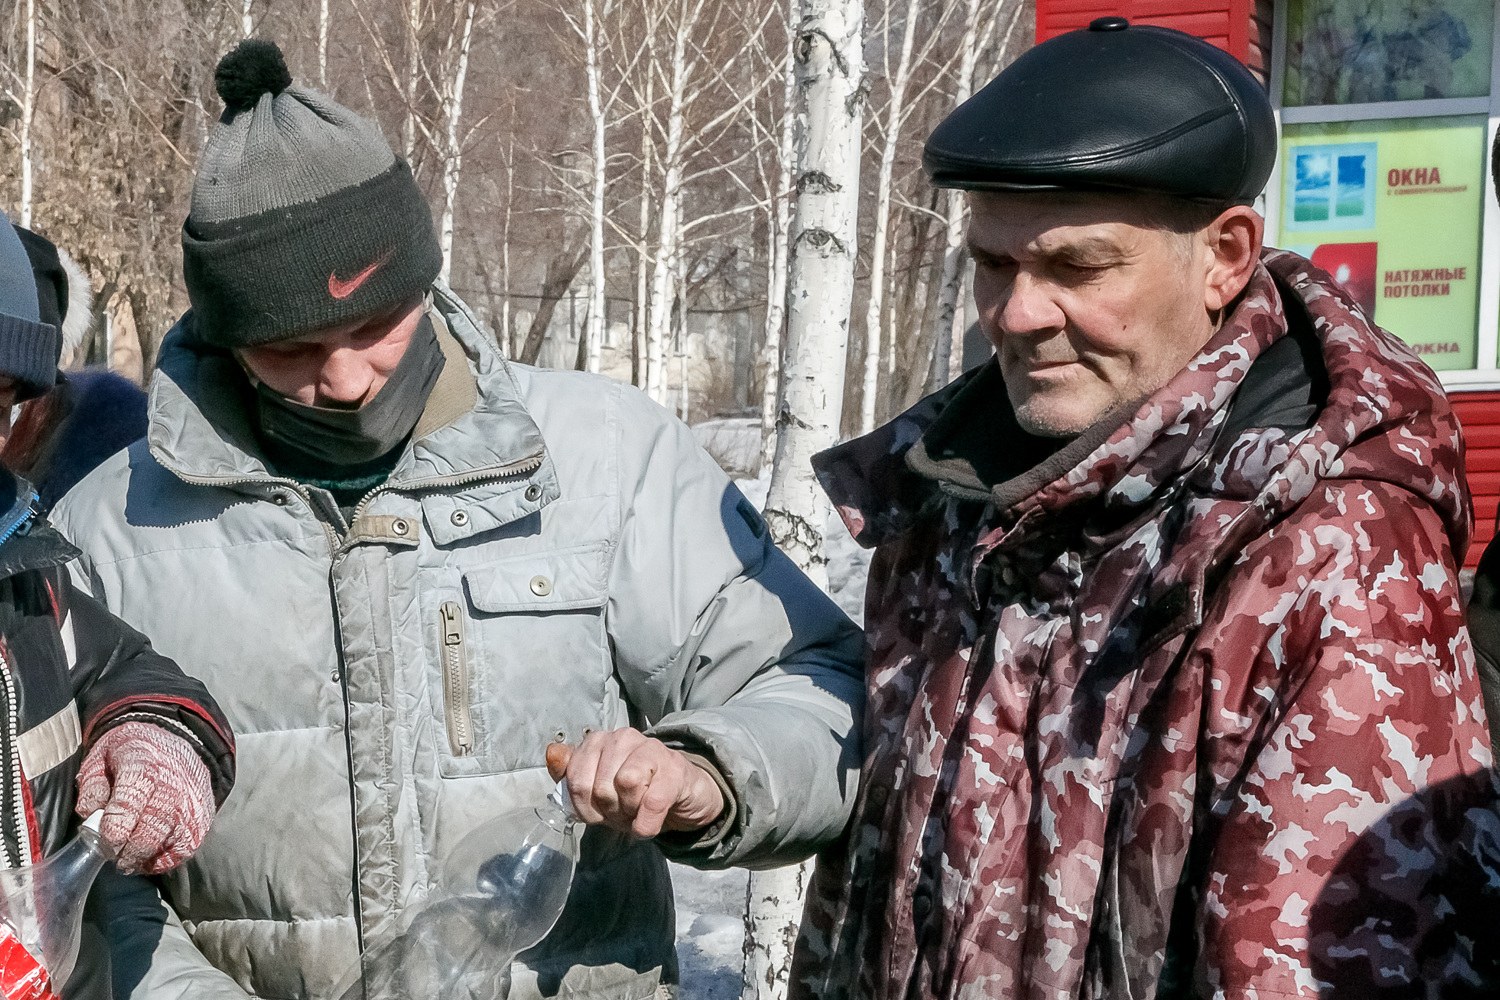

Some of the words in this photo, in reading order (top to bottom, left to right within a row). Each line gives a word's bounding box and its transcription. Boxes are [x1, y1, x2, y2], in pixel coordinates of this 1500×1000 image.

[1387, 167, 1441, 186] ОКНА
[1384, 267, 1466, 283] НАТЯЖНЫЕ
[1384, 283, 1450, 298] ПОТОЛКИ
[1411, 342, 1460, 354] ОКНА
